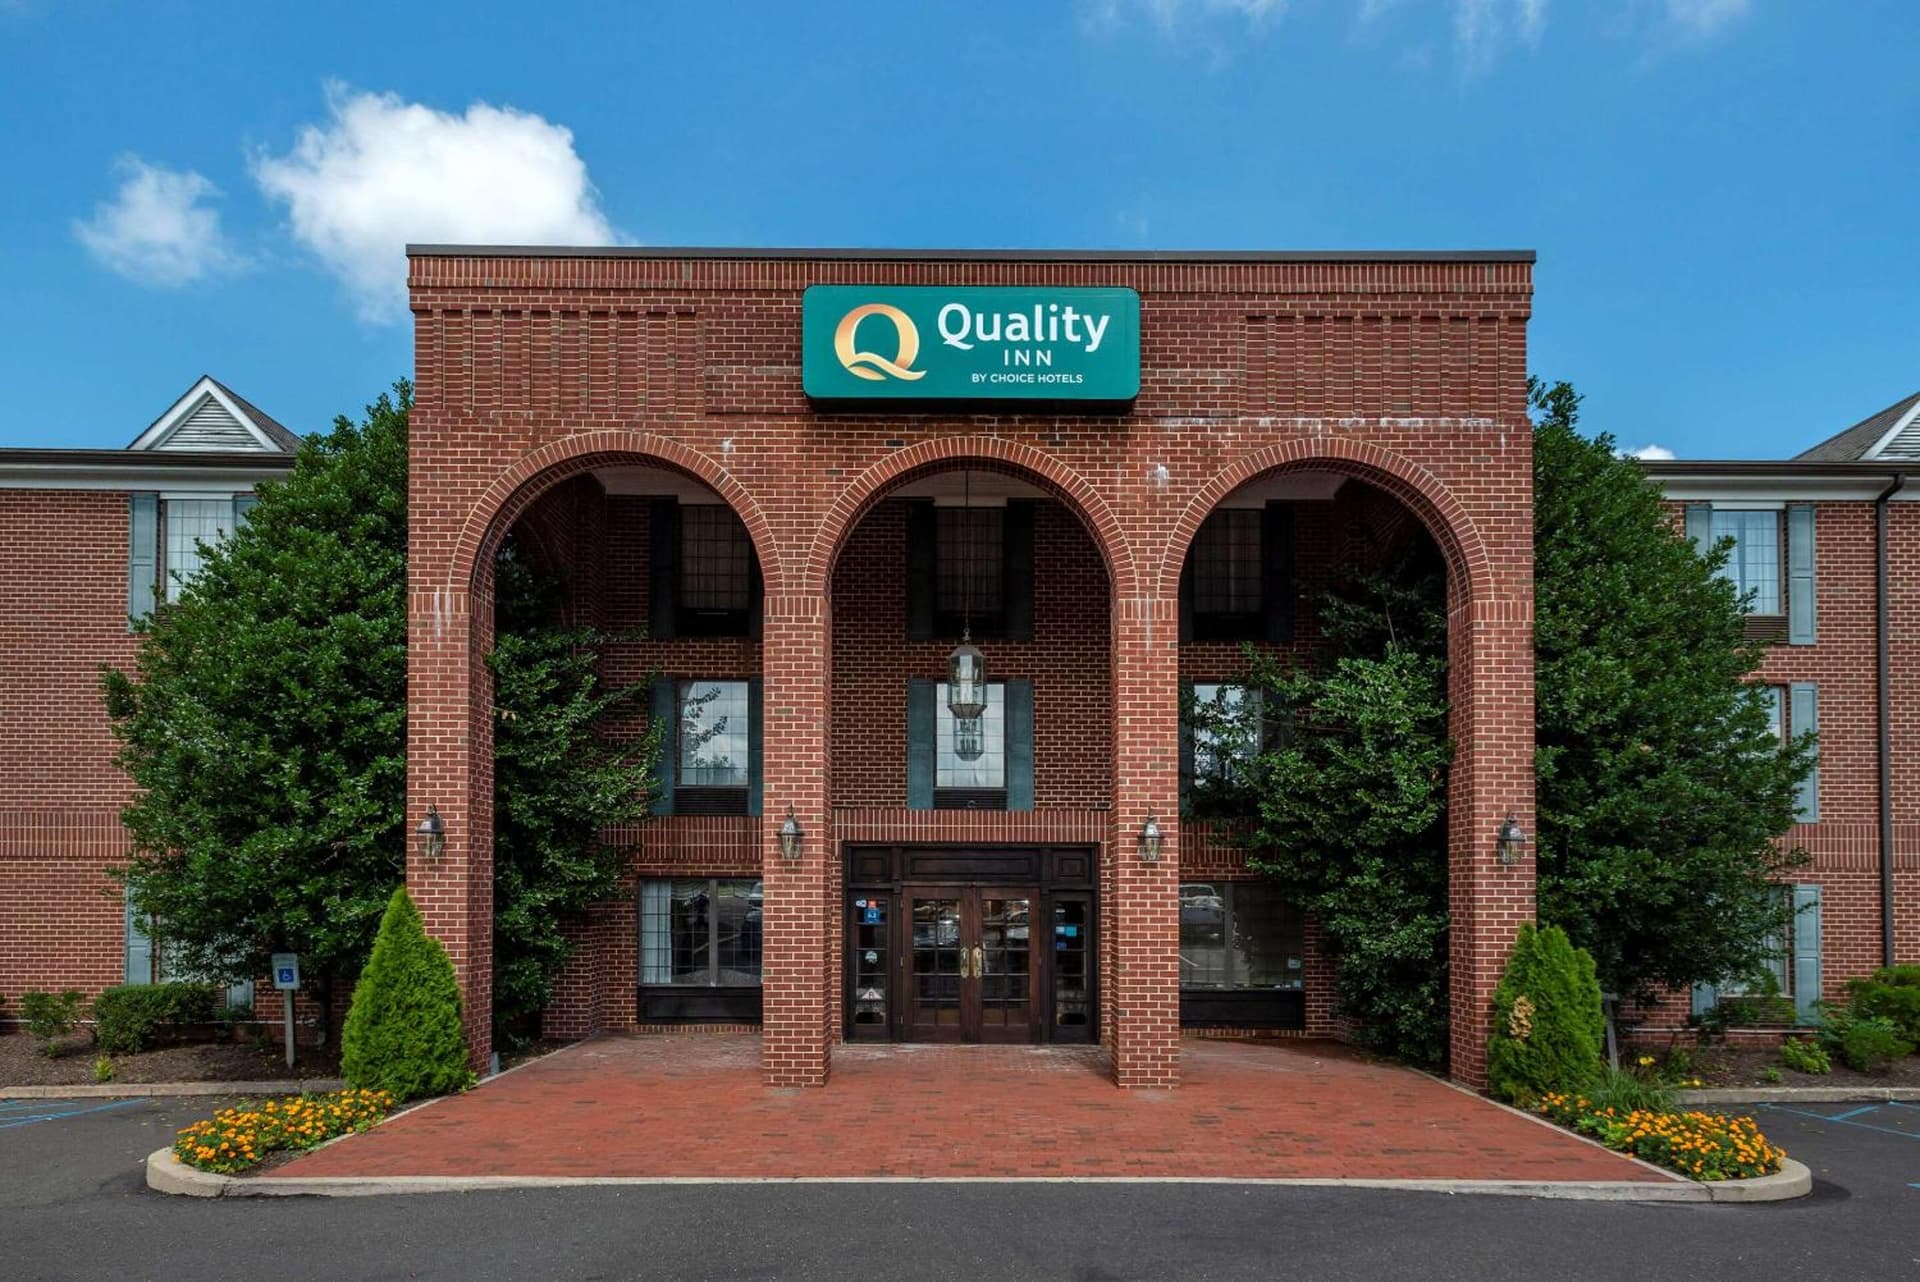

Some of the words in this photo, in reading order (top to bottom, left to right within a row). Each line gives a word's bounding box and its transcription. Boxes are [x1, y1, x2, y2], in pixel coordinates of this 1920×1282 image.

[834, 303, 927, 381] Q
[937, 302, 1110, 352] Quality
[1003, 350, 1052, 366] INN
[971, 373, 987, 383] BY
[990, 373, 1034, 383] CHOICE
[1038, 373, 1083, 383] HOTELS
